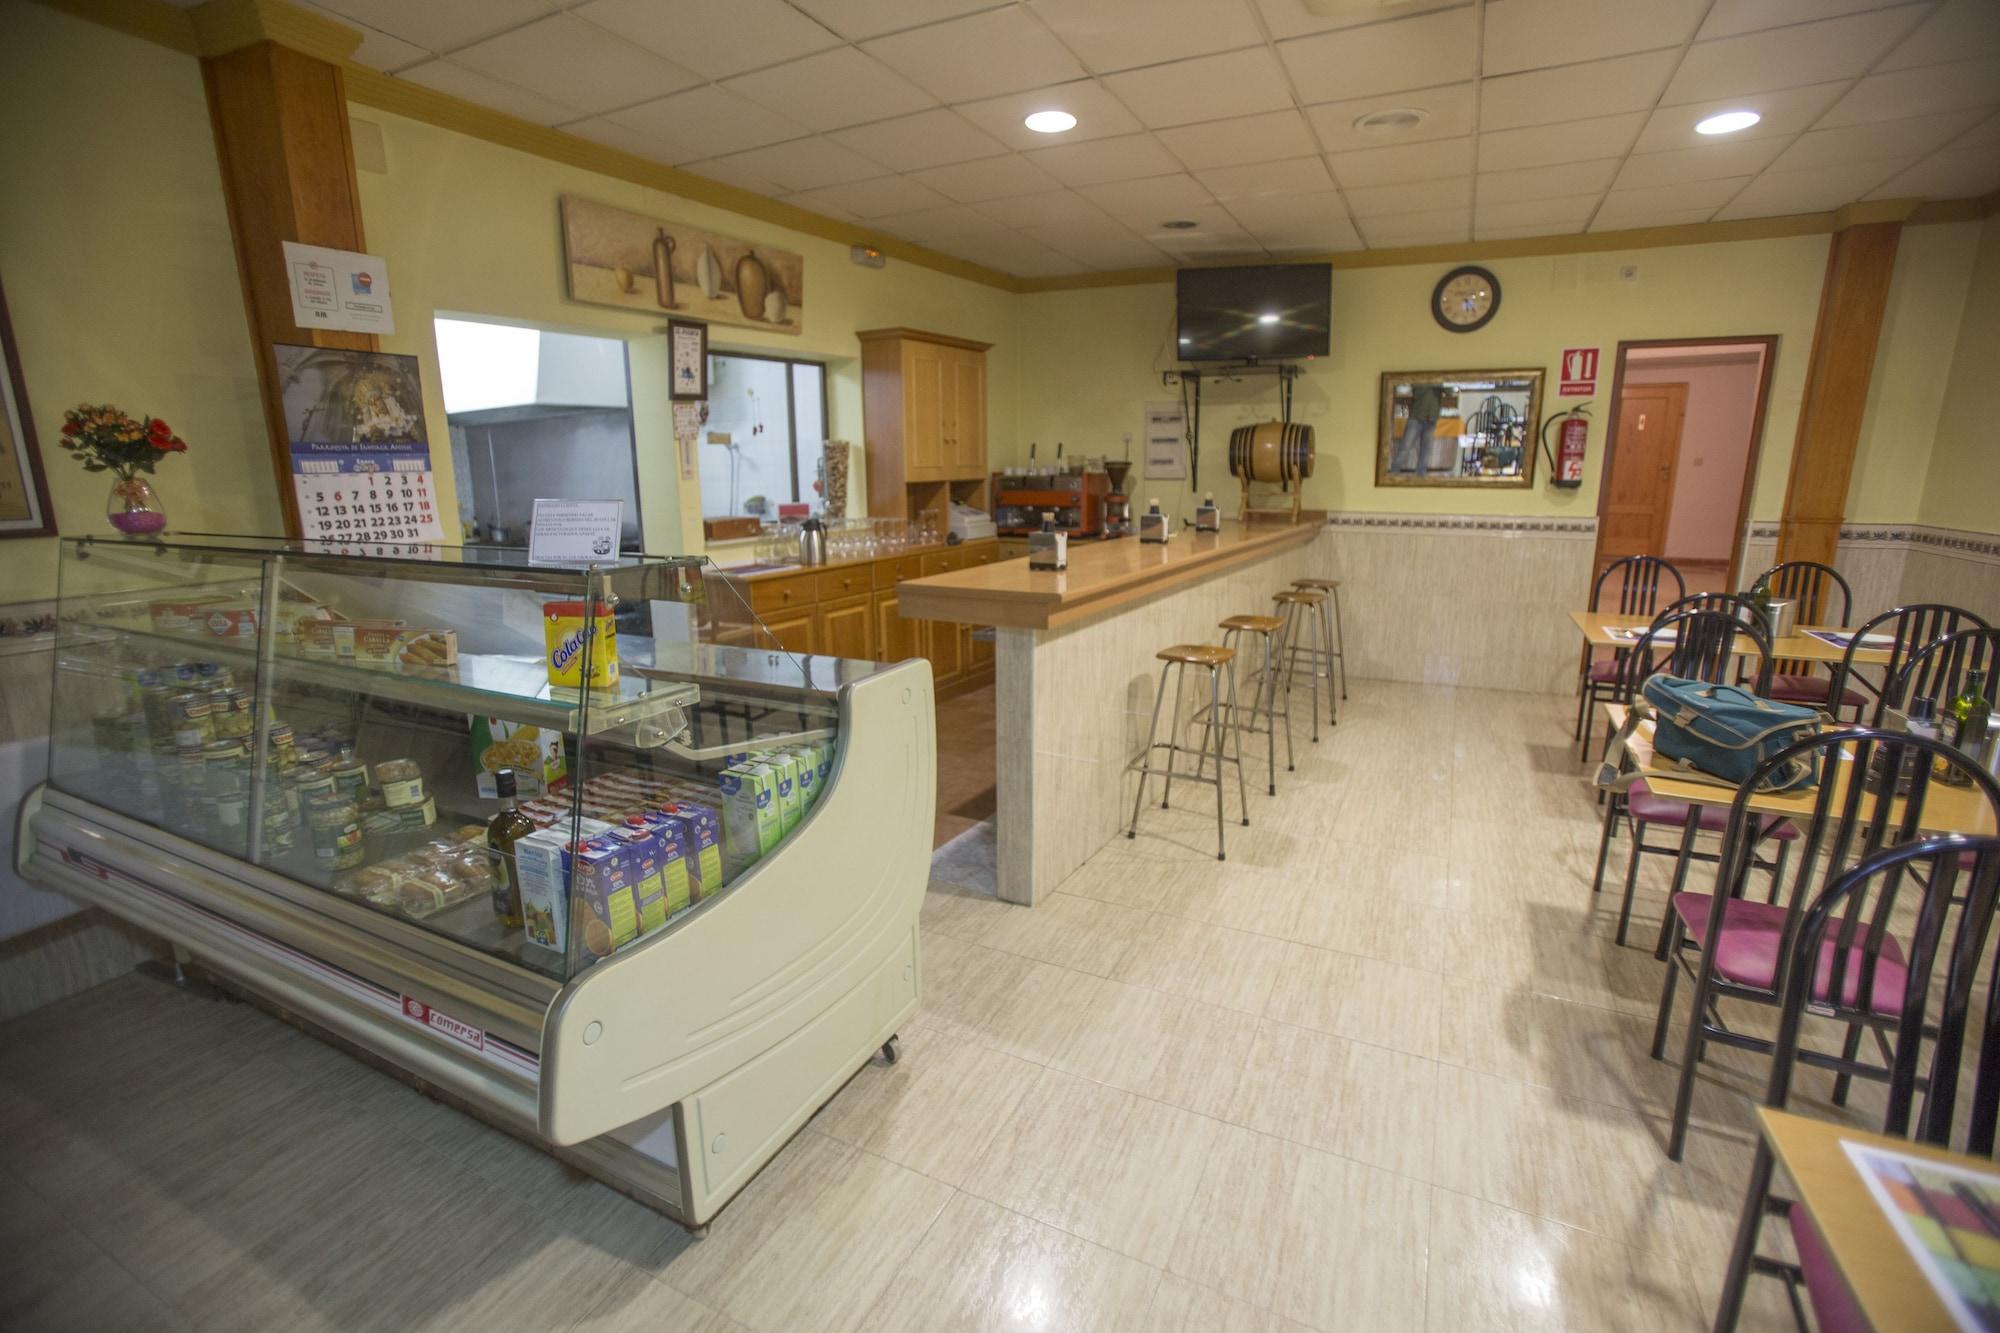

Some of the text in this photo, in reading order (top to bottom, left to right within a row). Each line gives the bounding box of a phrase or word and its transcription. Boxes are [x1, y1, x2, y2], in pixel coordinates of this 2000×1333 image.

[368, 475, 423, 485] 1 2 3 4
[316, 488, 426, 501] 5 6 7 8 9 10 11
[316, 502, 430, 516] 12 13 14 15 16 17 18
[318, 514, 432, 530] 19 20 21 22 23 24 25
[356, 533, 371, 542] 28
[374, 531, 388, 540] 29
[390, 530, 404, 539] 30
[407, 528, 419, 537] 31
[430, 1012, 480, 1042] comersa
